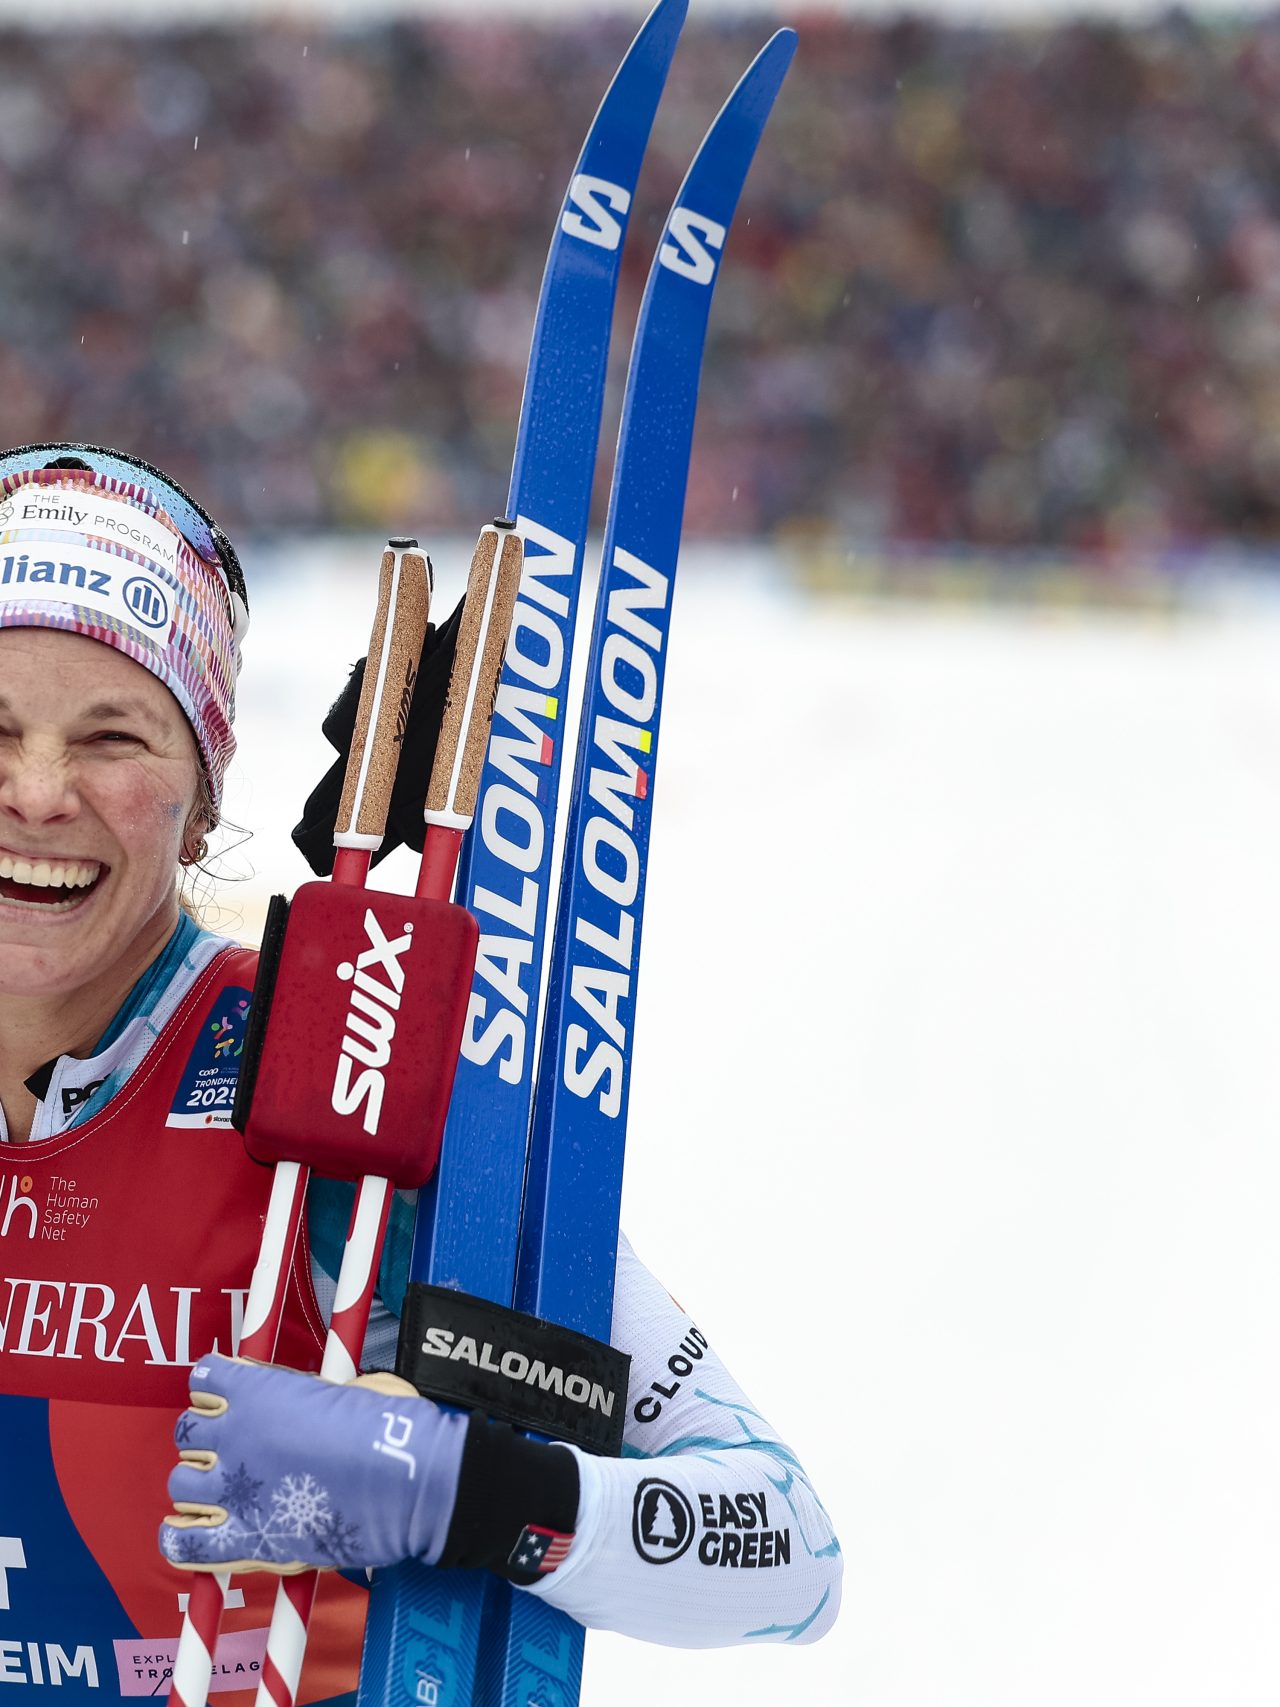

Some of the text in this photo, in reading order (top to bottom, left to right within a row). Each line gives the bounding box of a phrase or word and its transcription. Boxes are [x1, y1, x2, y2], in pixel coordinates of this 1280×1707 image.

[33, 494, 60, 505] THE
[20, 504, 175, 564] Emily PROGRAM
[459, 513, 577, 1085] SALOMON
[564, 545, 670, 1119] SALOMON
[331, 907, 413, 1137] swix
[194, 1077, 238, 1088] TRONDHEI
[50, 1176, 77, 1192] The
[46, 1192, 99, 1210] Human
[43, 1209, 90, 1226] Safety
[41, 1226, 67, 1241] Net
[421, 1326, 615, 1417] SALOMON
[633, 1326, 709, 1424] CLOUD
[697, 1491, 769, 1530] EASY
[697, 1528, 791, 1569] GREEN
[132, 1653, 176, 1665] EXPL
[133, 1660, 261, 1680] TRØELAG
